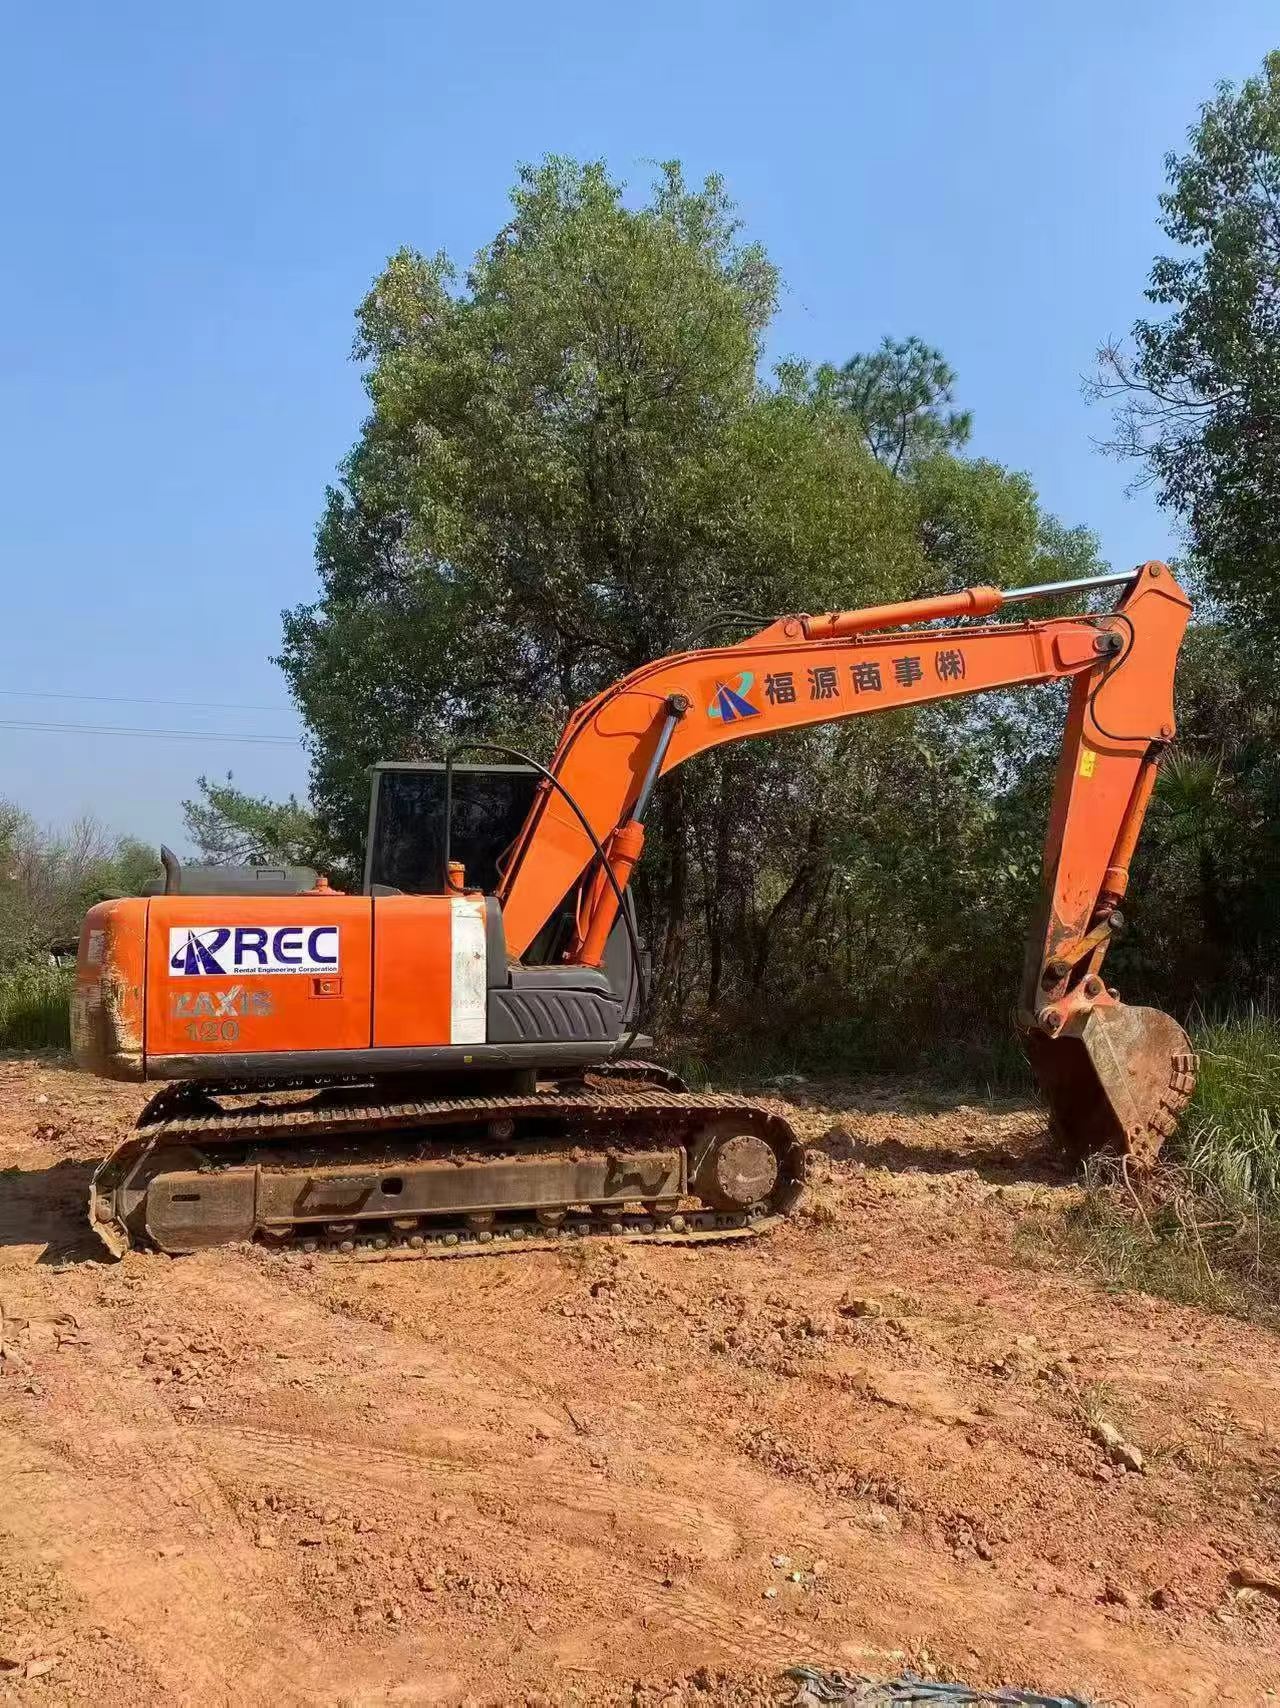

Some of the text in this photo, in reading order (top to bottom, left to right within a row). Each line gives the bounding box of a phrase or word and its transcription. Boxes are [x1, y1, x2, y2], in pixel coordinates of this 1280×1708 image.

[234, 927, 337, 965] REC
[258, 966, 296, 974] Engineering
[298, 966, 337, 974] Corporation
[184, 1020, 240, 1040] 120
